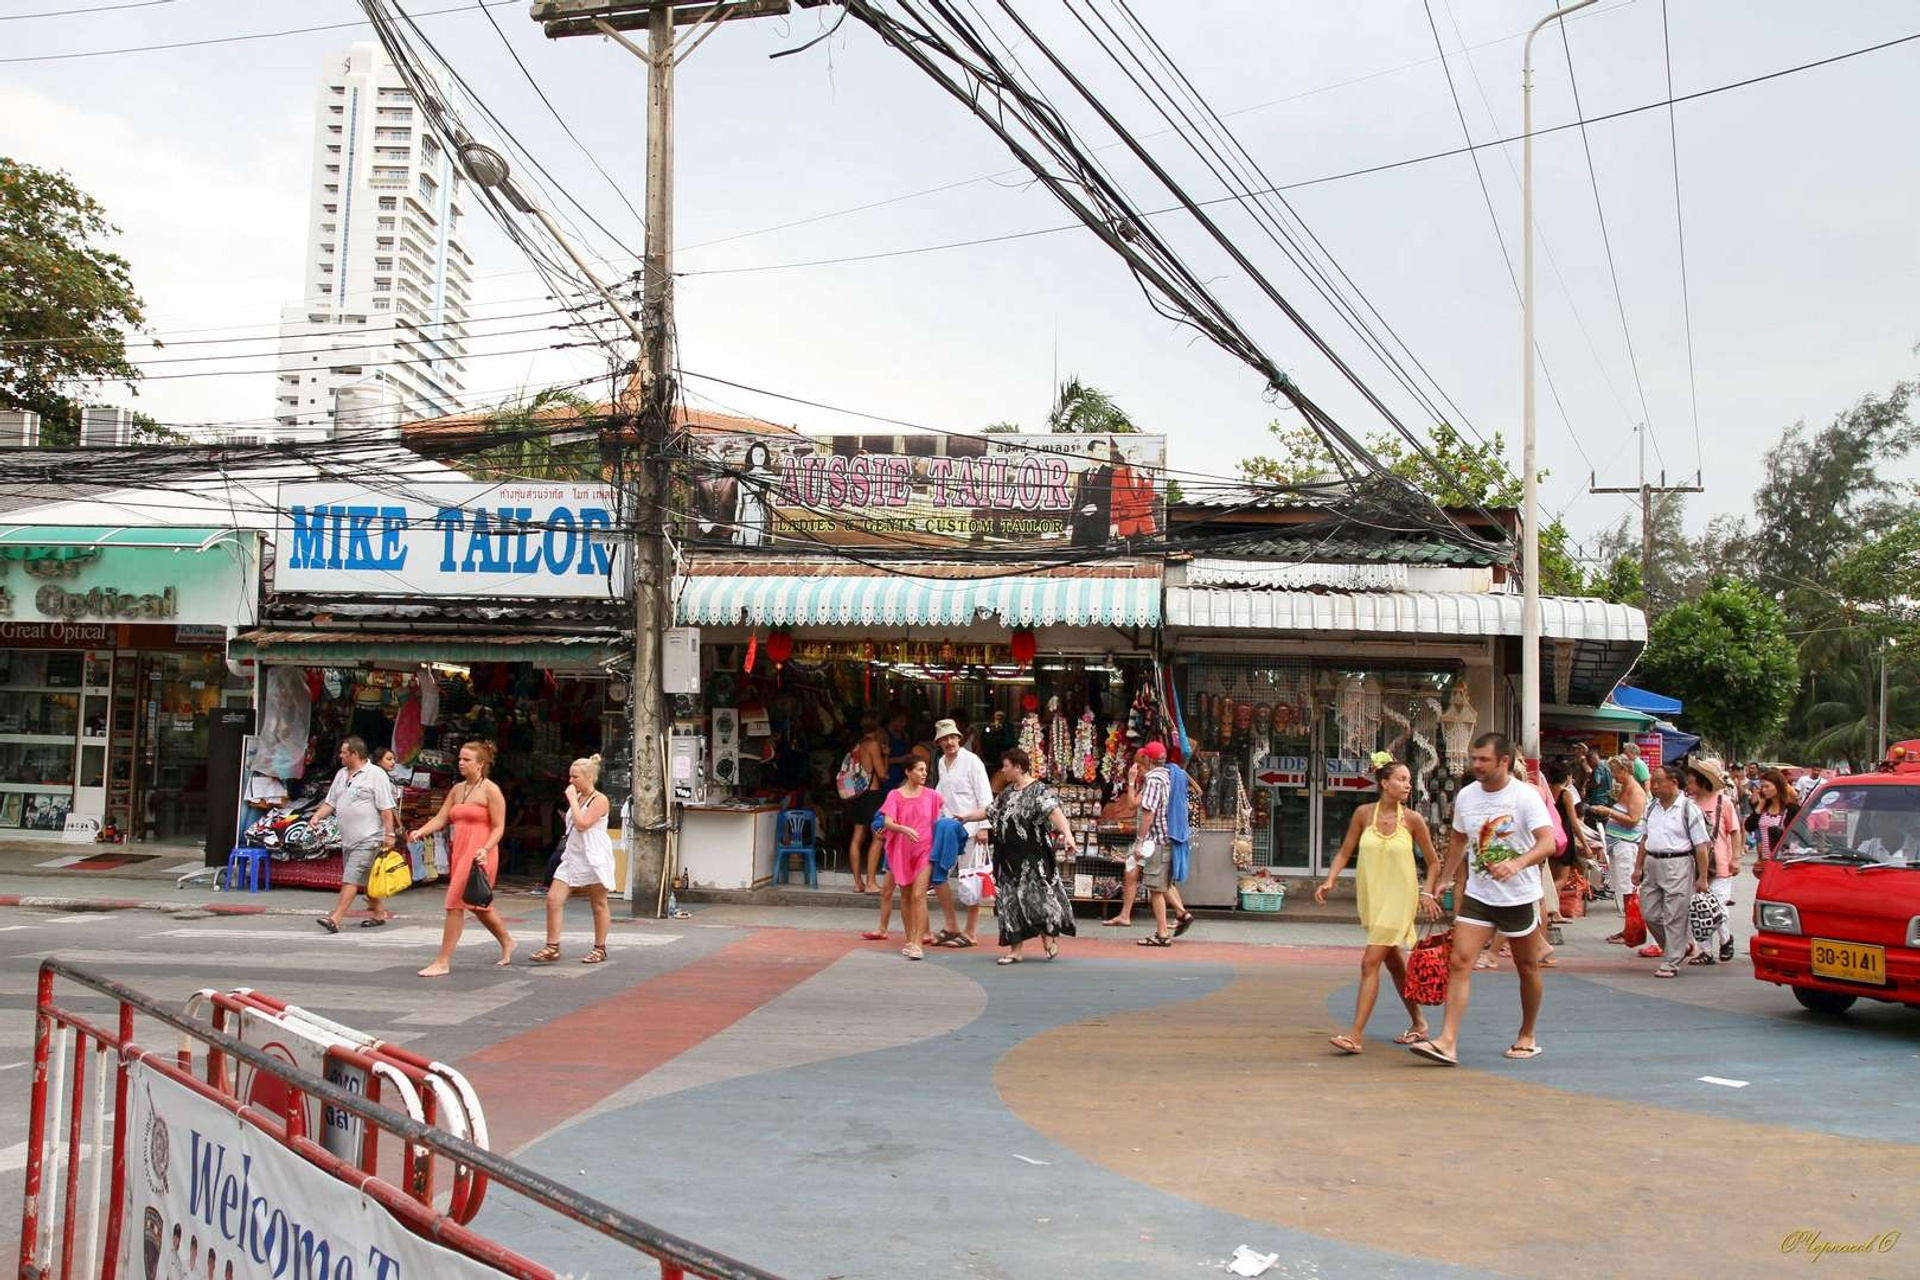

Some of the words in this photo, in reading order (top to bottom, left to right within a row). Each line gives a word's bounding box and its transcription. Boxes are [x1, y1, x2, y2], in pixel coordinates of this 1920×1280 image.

[776, 456, 911, 508] AUSSIE
[928, 456, 1072, 509] TAILOR
[778, 519, 836, 532] LADIES
[863, 519, 916, 532] GENTS
[925, 519, 993, 533] CUSTOM
[1001, 520, 1063, 533] TAILOR
[289, 504, 408, 571] MIKE
[435, 505, 611, 576] TAILOR
[36, 584, 177, 622] Optical
[1, 621, 46, 639] Great
[50, 621, 106, 643] Optical
[1256, 757, 1308, 770] SLIDE
[1816, 946, 1877, 971] 30-3141
